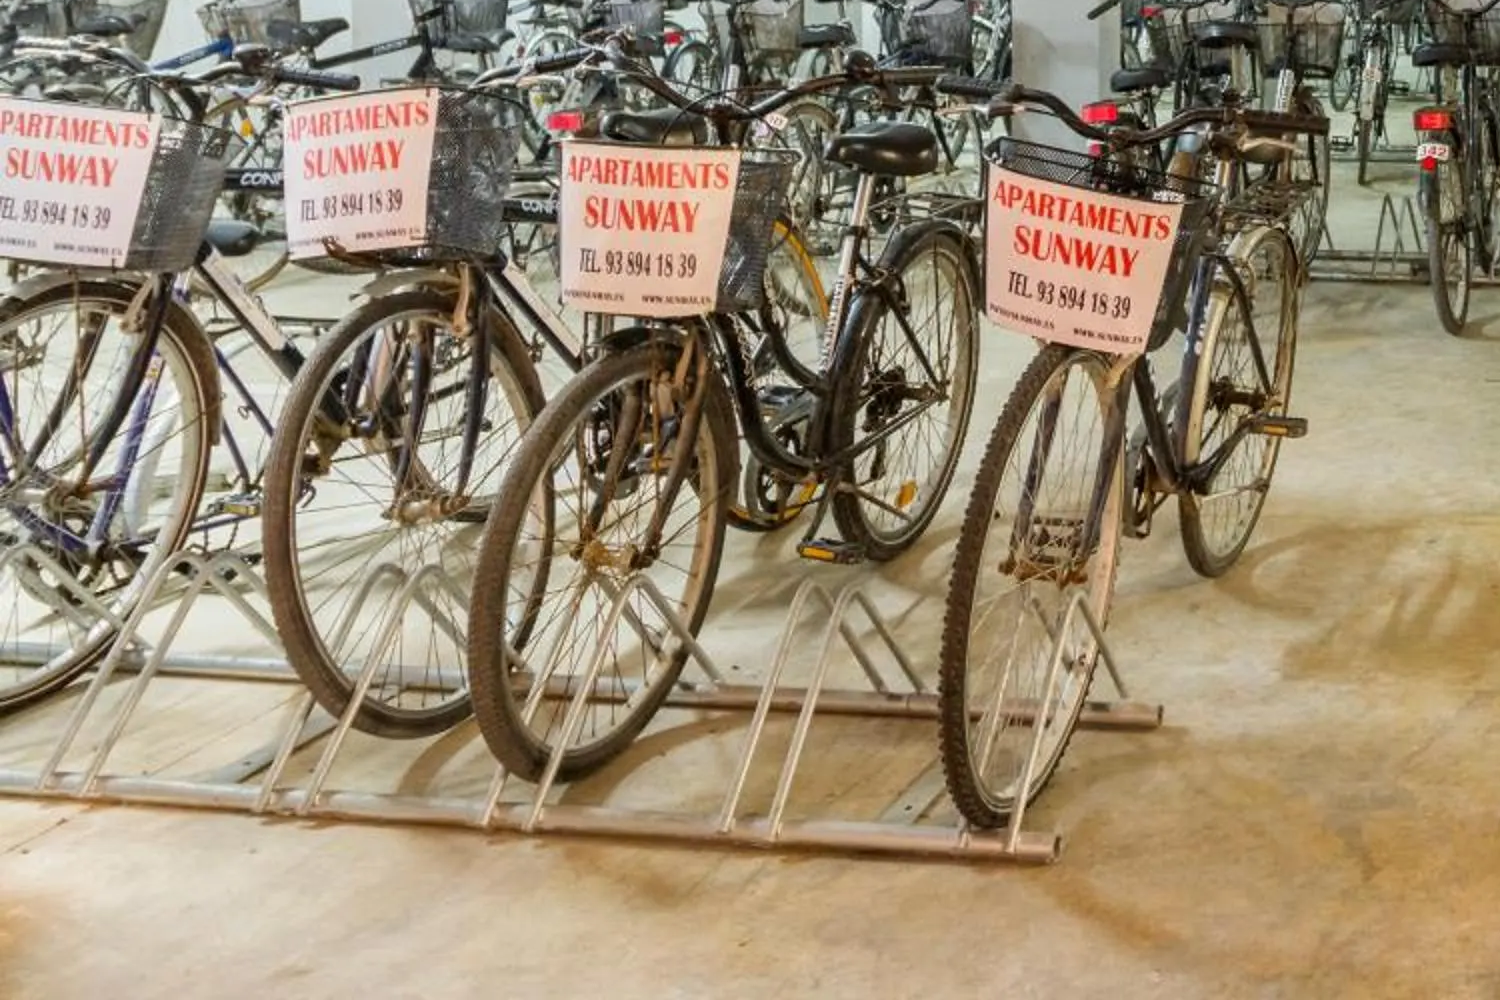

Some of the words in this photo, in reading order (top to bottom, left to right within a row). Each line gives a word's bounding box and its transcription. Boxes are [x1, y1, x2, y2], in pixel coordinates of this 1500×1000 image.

[0, 110, 149, 149] PARTAMENTS
[288, 101, 429, 142] APARTAMENTS
[5, 147, 119, 188] SUNWAY
[303, 138, 405, 180] SUNWAY
[568, 155, 730, 190] APARTAMENTS
[22, 199, 39, 223] 93
[41, 201, 66, 225] 894
[72, 204, 89, 229] 18
[92, 207, 111, 230] 39
[322, 196, 337, 219] 93
[340, 192, 363, 216] 894
[368, 190, 383, 214] 18
[385, 188, 403, 212] 39
[583, 196, 700, 233] SUNWAY
[993, 179, 1171, 240] APARTAMENTS
[605, 250, 623, 275] 93
[626, 251, 651, 277] 894
[657, 253, 673, 277] 18
[677, 254, 697, 278] 39
[1013, 225, 1140, 277] SUNWAY
[1007, 271, 1033, 298] TEL.
[1037, 280, 1054, 305] 93
[1057, 285, 1086, 311] 894
[1091, 291, 1108, 316] 18
[1111, 295, 1131, 319] 39
